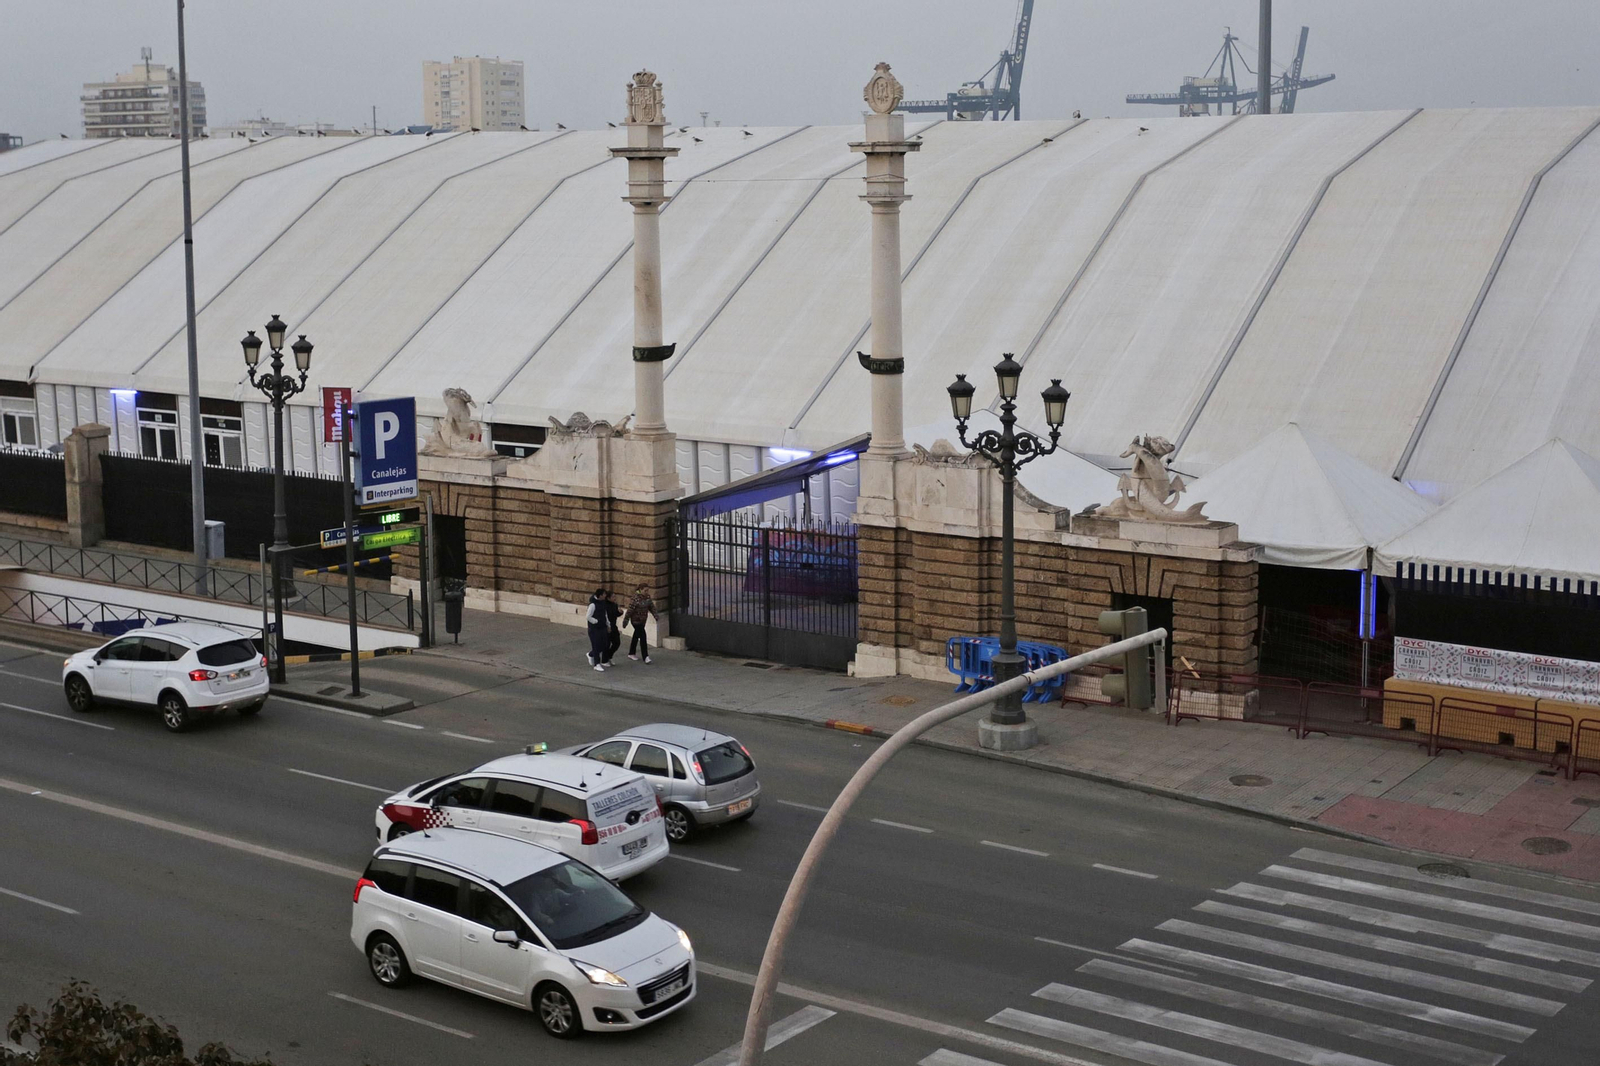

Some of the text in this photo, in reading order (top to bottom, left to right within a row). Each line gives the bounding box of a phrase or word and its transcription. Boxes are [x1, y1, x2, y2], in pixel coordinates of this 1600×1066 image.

[374, 411, 400, 460] P
[371, 467, 407, 479] Canalejas
[374, 486, 414, 498] Interparking
[381, 513, 400, 524] LIBRE
[324, 532, 330, 540] P
[1398, 647, 1428, 657] CARNAVAL
[1467, 648, 1489, 656] DYC
[1463, 656, 1494, 665] CARNAVAL
[591, 794, 618, 810] TALLERES
